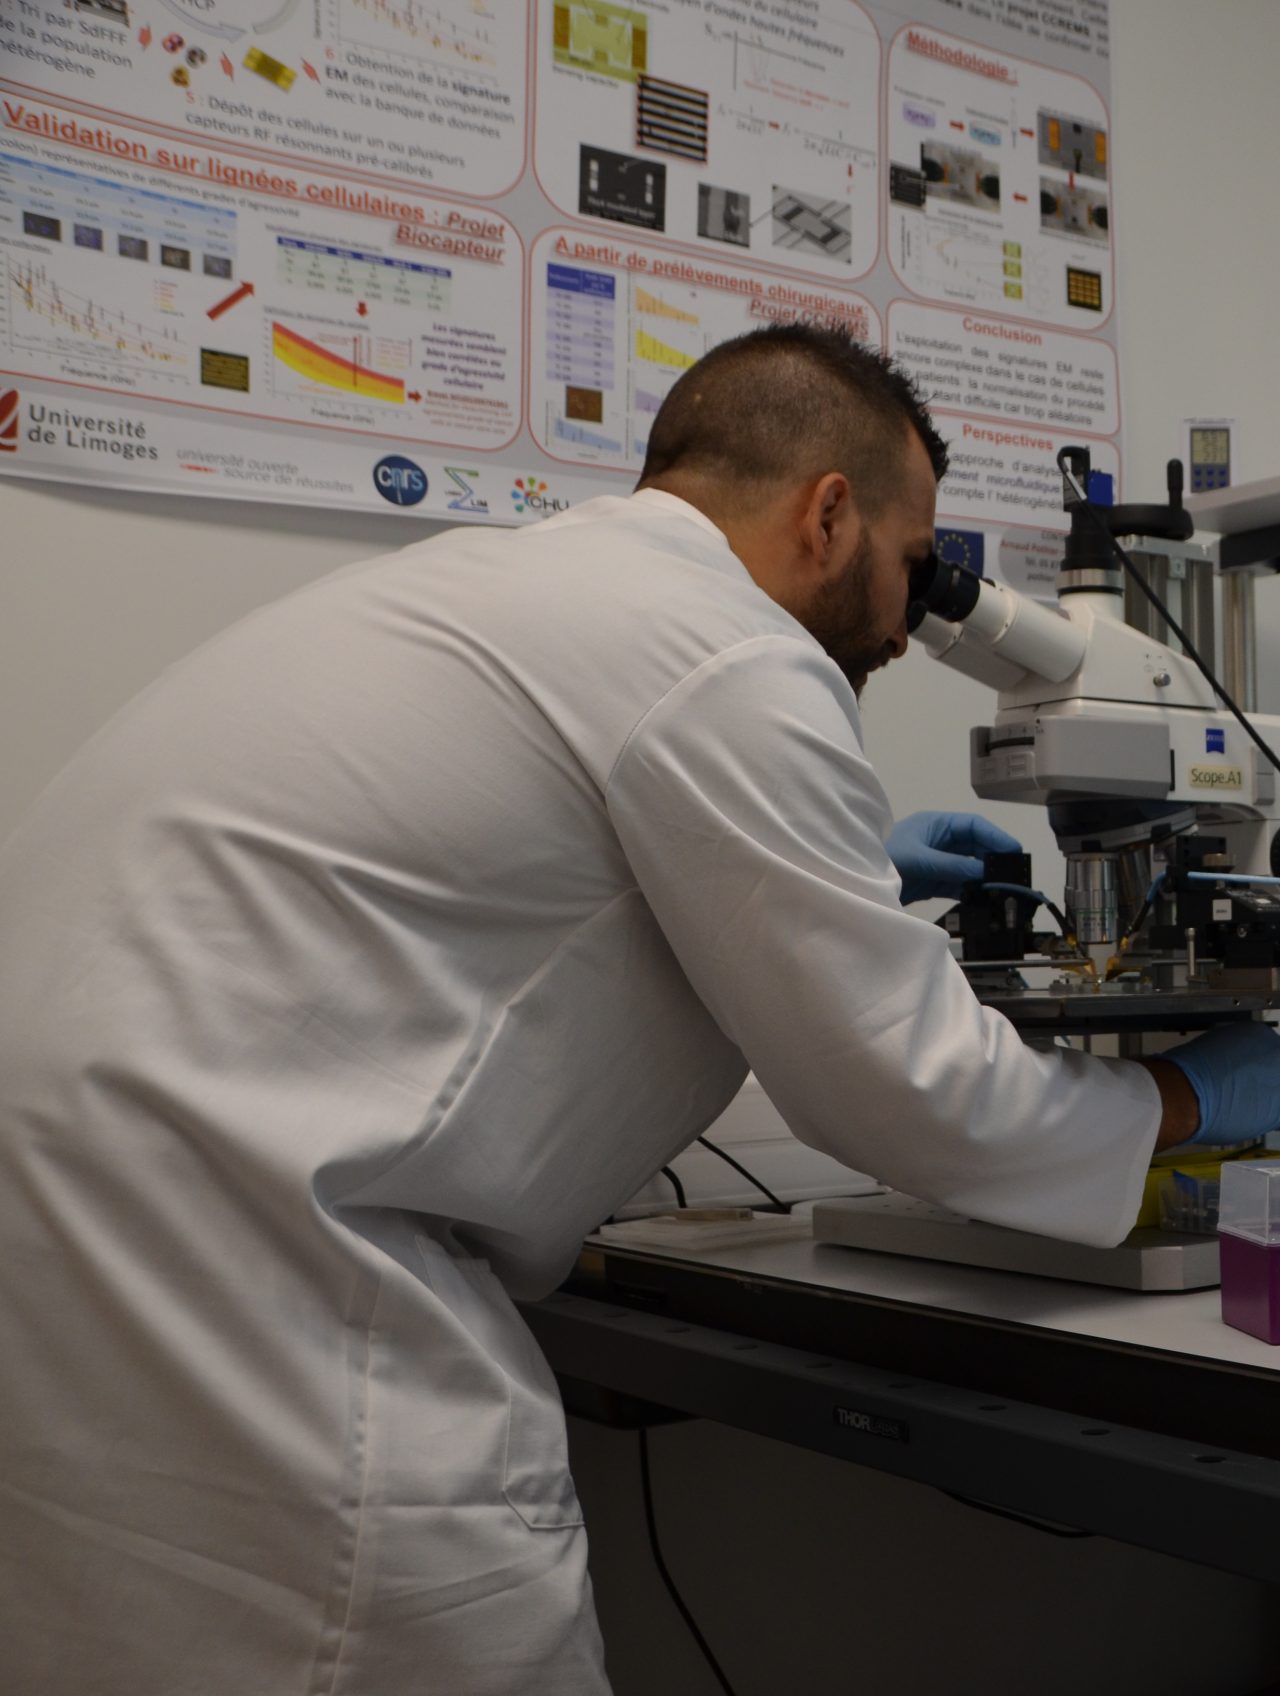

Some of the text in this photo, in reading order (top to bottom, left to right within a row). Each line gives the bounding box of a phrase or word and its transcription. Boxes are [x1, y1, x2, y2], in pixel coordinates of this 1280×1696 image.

[18, 0, 128, 47] Tri par SdFFF
[20, 20, 37, 39] la
[41, 30, 133, 69] population
[906, 29, 1009, 81] Méthodologie
[324, 65, 349, 84] EM
[352, 72, 377, 90] des
[434, 94, 515, 125] comparaison
[346, 51, 415, 81] Obtention
[417, 69, 435, 86] de
[437, 74, 449, 89] la
[451, 80, 511, 106] signature
[207, 94, 253, 121] Dépôt
[257, 109, 283, 127] des
[287, 116, 339, 140] cellules
[342, 130, 363, 144] sur
[366, 135, 385, 149] un
[387, 139, 406, 155] ou
[407, 144, 466, 169] plusieurs
[325, 87, 502, 140] avec la banque de données
[185, 112, 434, 180] capteurs RF résonnants pré-calibrés
[3, 99, 149, 160] Validation
[155, 149, 201, 173] sur
[208, 156, 298, 195] lignées
[305, 183, 426, 224] cellulaires
[446, 211, 506, 242] Projet
[395, 222, 506, 262] Biocapteur
[554, 235, 569, 252] A
[574, 239, 621, 268] partir
[626, 248, 648, 270] de
[653, 256, 764, 296] prélèvements
[962, 316, 1043, 346] Conclusion
[896, 331, 963, 353] L'exploitation
[970, 346, 989, 359] des
[998, 351, 1048, 371] signatures
[1055, 360, 1073, 375] EM
[933, 356, 983, 375] complexe
[985, 364, 1012, 380] dans
[1027, 373, 1047, 386] cas
[1049, 376, 1064, 389] de
[1066, 379, 1105, 396] cellules
[1003, 402, 1021, 414] car
[1023, 405, 1045, 421] trop
[1047, 407, 1092, 427] aléatoire
[1050, 391, 1064, 405] du
[27, 403, 147, 439] Université
[962, 423, 1054, 452] Perspectives
[27, 424, 159, 462] de Limoges
[176, 449, 299, 475] université ouverte
[224, 467, 354, 494] source de réussites
[377, 467, 423, 495] cnrs
[943, 485, 985, 500] compte
[530, 495, 571, 512] CHU
[1191, 767, 1242, 788] Scope.A1
